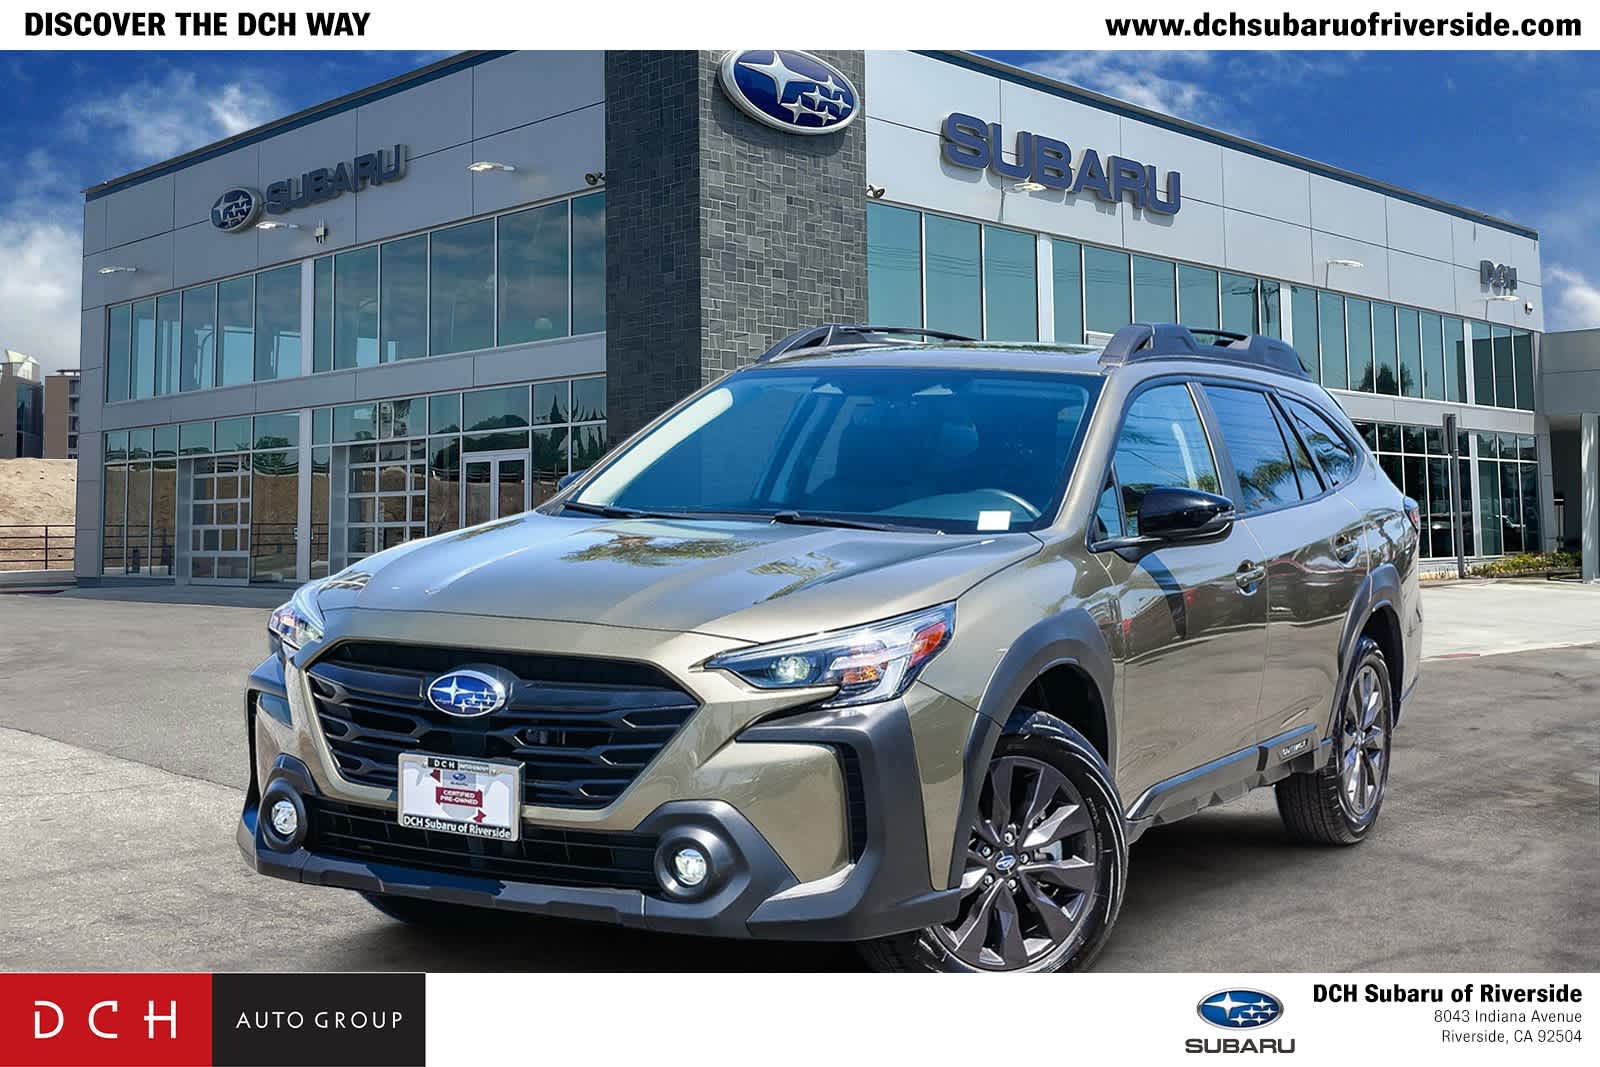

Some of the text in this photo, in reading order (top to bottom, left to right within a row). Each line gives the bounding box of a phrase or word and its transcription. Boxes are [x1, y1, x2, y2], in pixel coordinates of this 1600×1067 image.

[940, 112, 1181, 215] SUBARU
[266, 144, 407, 214] SUBARU
[433, 759, 456, 769] DCH
[440, 795, 478, 805] PRE-OWNED
[443, 789, 475, 799] CERTIFIED
[403, 816, 511, 839] DCH Subaru of Riverside
